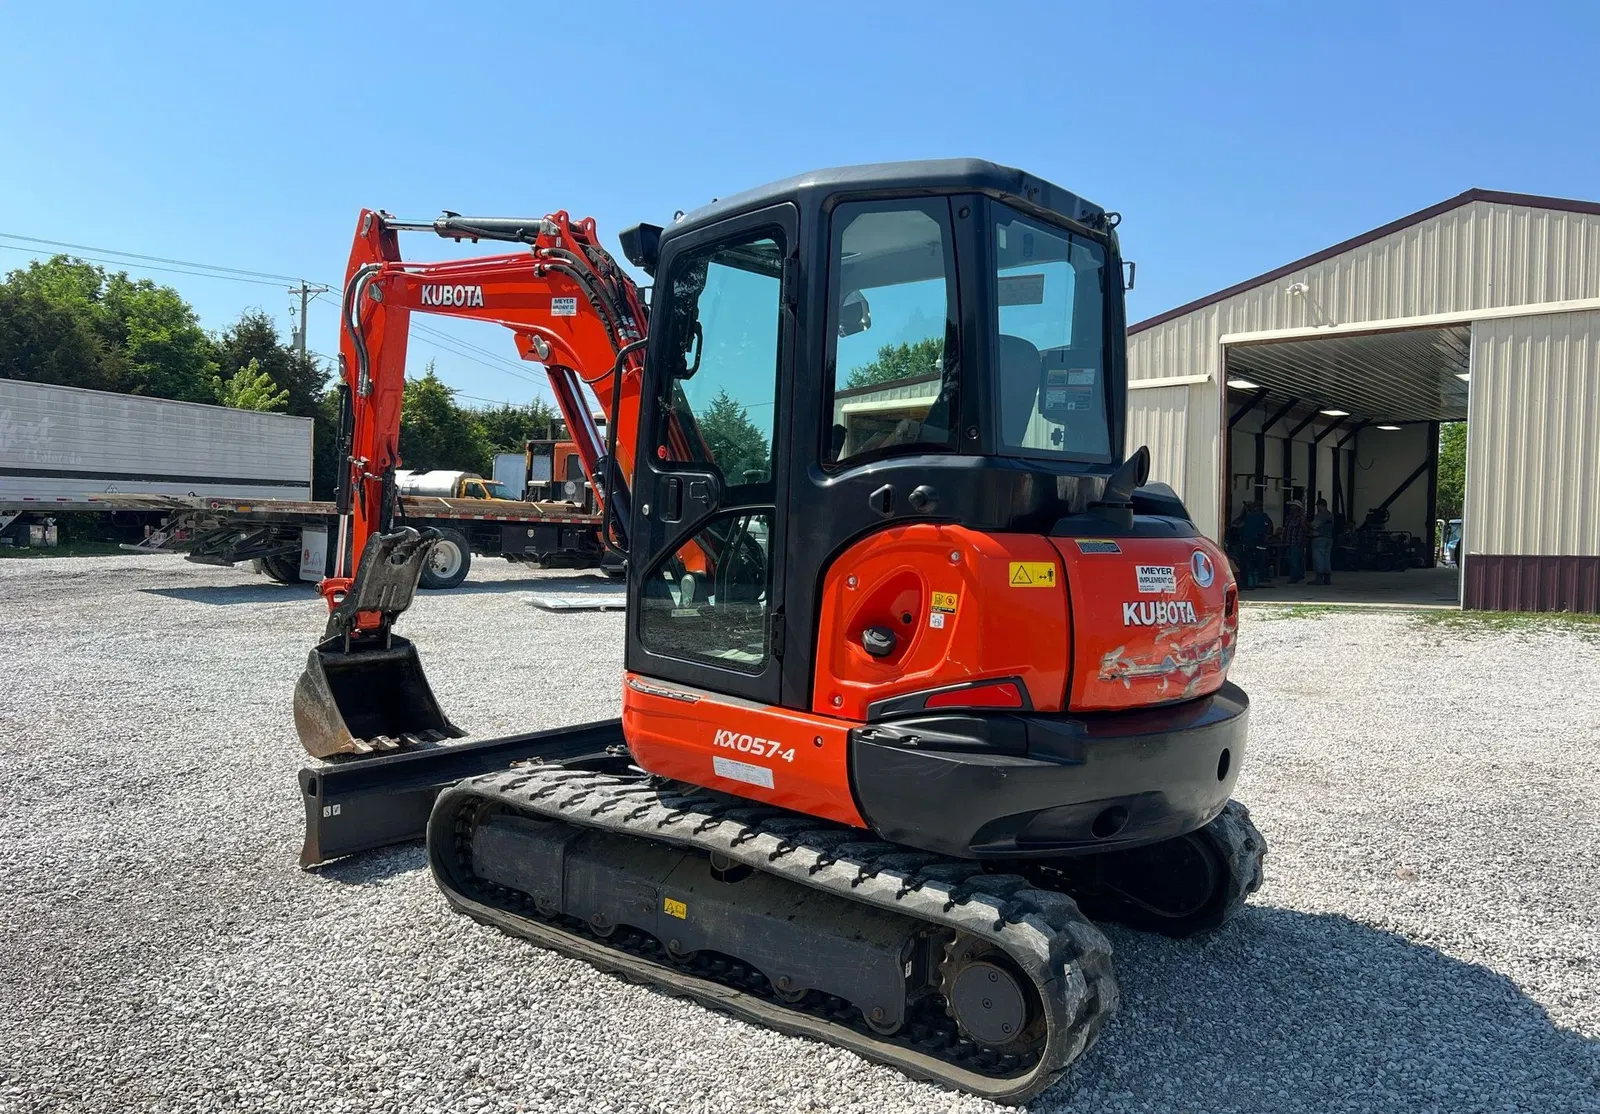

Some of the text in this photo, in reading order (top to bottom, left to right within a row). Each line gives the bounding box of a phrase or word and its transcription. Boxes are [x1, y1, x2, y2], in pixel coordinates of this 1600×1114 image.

[421, 284, 484, 307] KUBOTA
[32, 448, 82, 465] Colorado
[1139, 576, 1167, 584] IMPLEMENT
[1140, 567, 1172, 575] MEYER
[1122, 601, 1197, 626] KUBOTA
[713, 729, 796, 763] KX057-4
